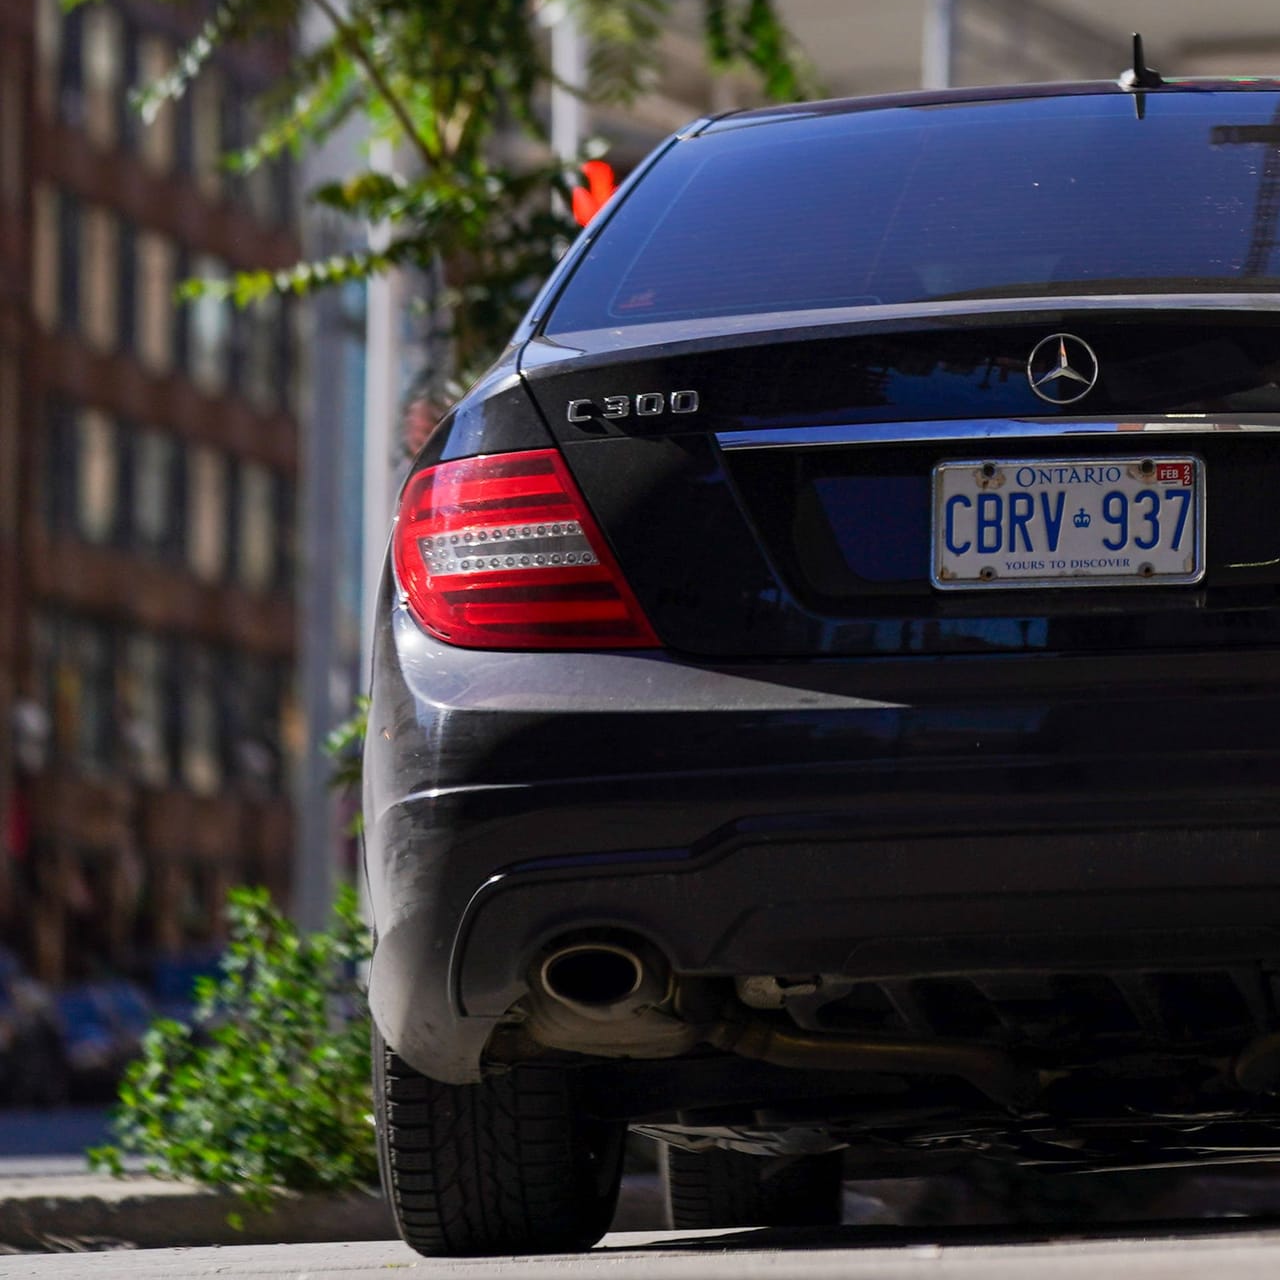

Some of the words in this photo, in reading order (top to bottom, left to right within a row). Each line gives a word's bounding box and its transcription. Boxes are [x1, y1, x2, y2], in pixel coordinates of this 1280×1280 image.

[1016, 466, 1122, 487] ONTARIO
[1160, 469, 1179, 480] FEB
[945, 490, 1066, 555] CBRV
[1102, 489, 1192, 551] 937
[1005, 560, 1047, 570] YOURS
[1049, 560, 1066, 569] TO
[1070, 557, 1130, 569] DISCOVER
